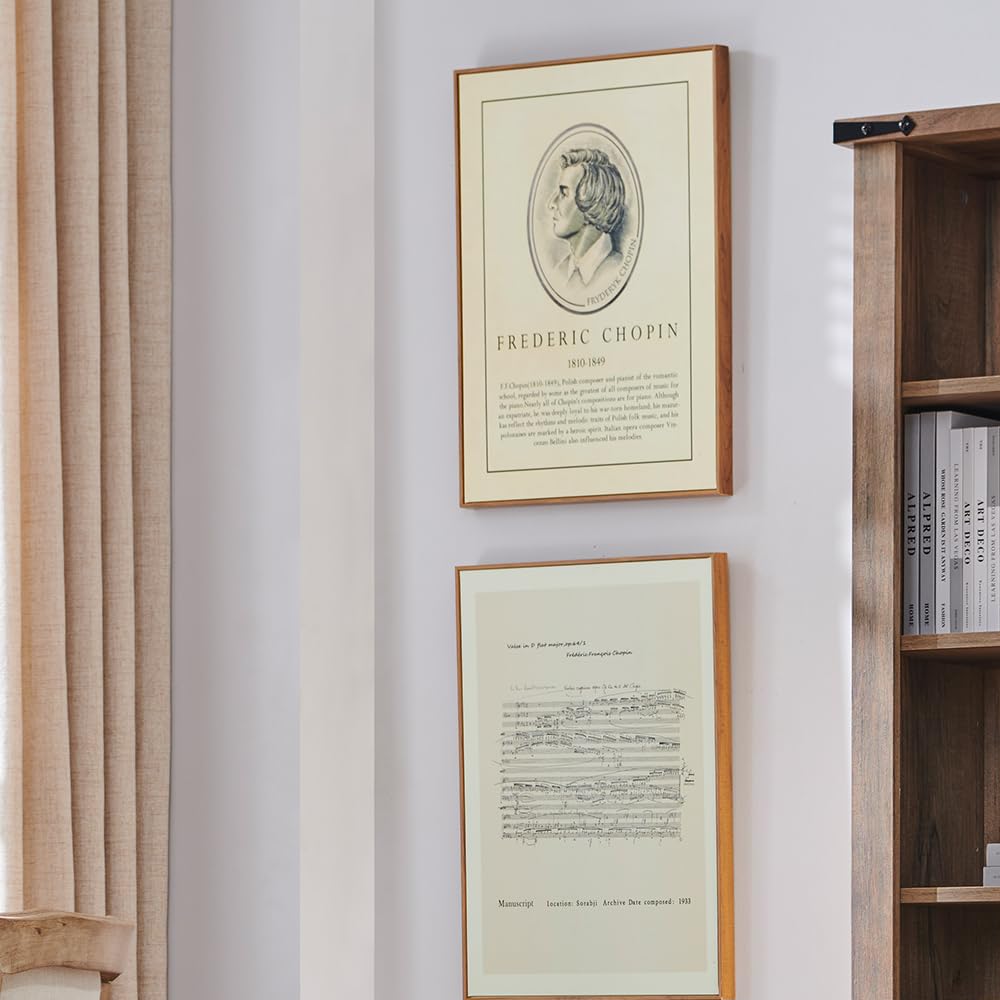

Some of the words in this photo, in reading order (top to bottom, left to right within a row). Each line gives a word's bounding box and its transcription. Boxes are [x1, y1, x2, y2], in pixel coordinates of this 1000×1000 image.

[619, 238, 638, 277] CHOPIN
[497, 328, 590, 351] FREDERIC
[602, 322, 679, 343] CHOPIN
[567, 356, 606, 369] 1810-1849
[907, 492, 916, 556] ALPRED
[923, 491, 931, 555] ALPRED
[498, 898, 534, 909] Manuscript
[602, 898, 626, 907] Archive
[628, 898, 642, 907] Date
